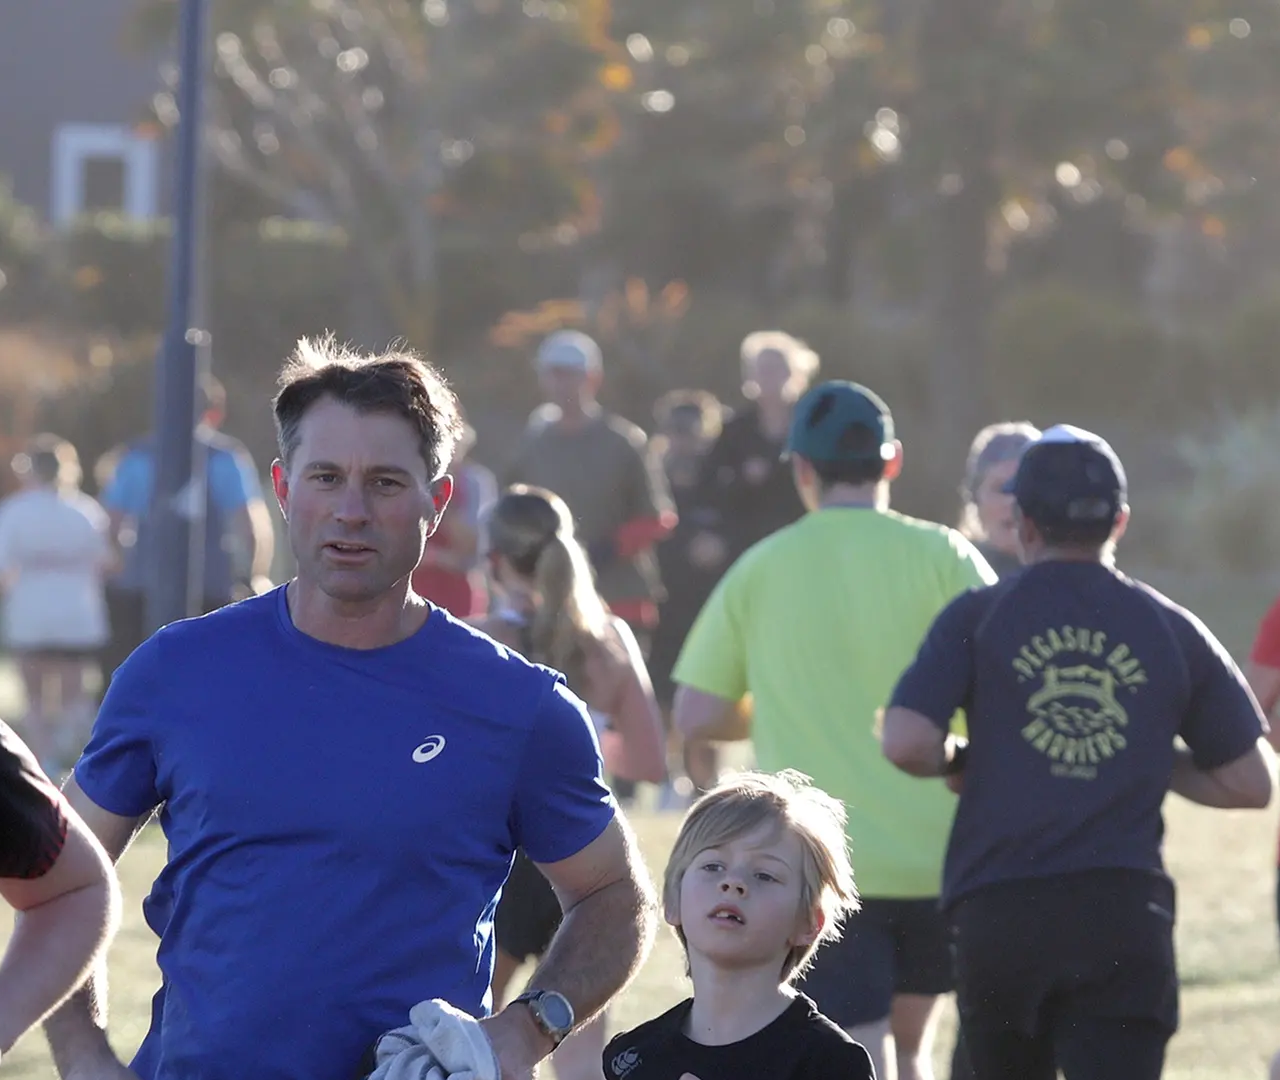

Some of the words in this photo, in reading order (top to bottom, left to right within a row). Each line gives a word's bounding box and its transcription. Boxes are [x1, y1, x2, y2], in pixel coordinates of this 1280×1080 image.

[1012, 625, 1107, 679] PEGASUS
[1106, 643, 1148, 684] BAY
[1021, 718, 1127, 765] HARRIERS
